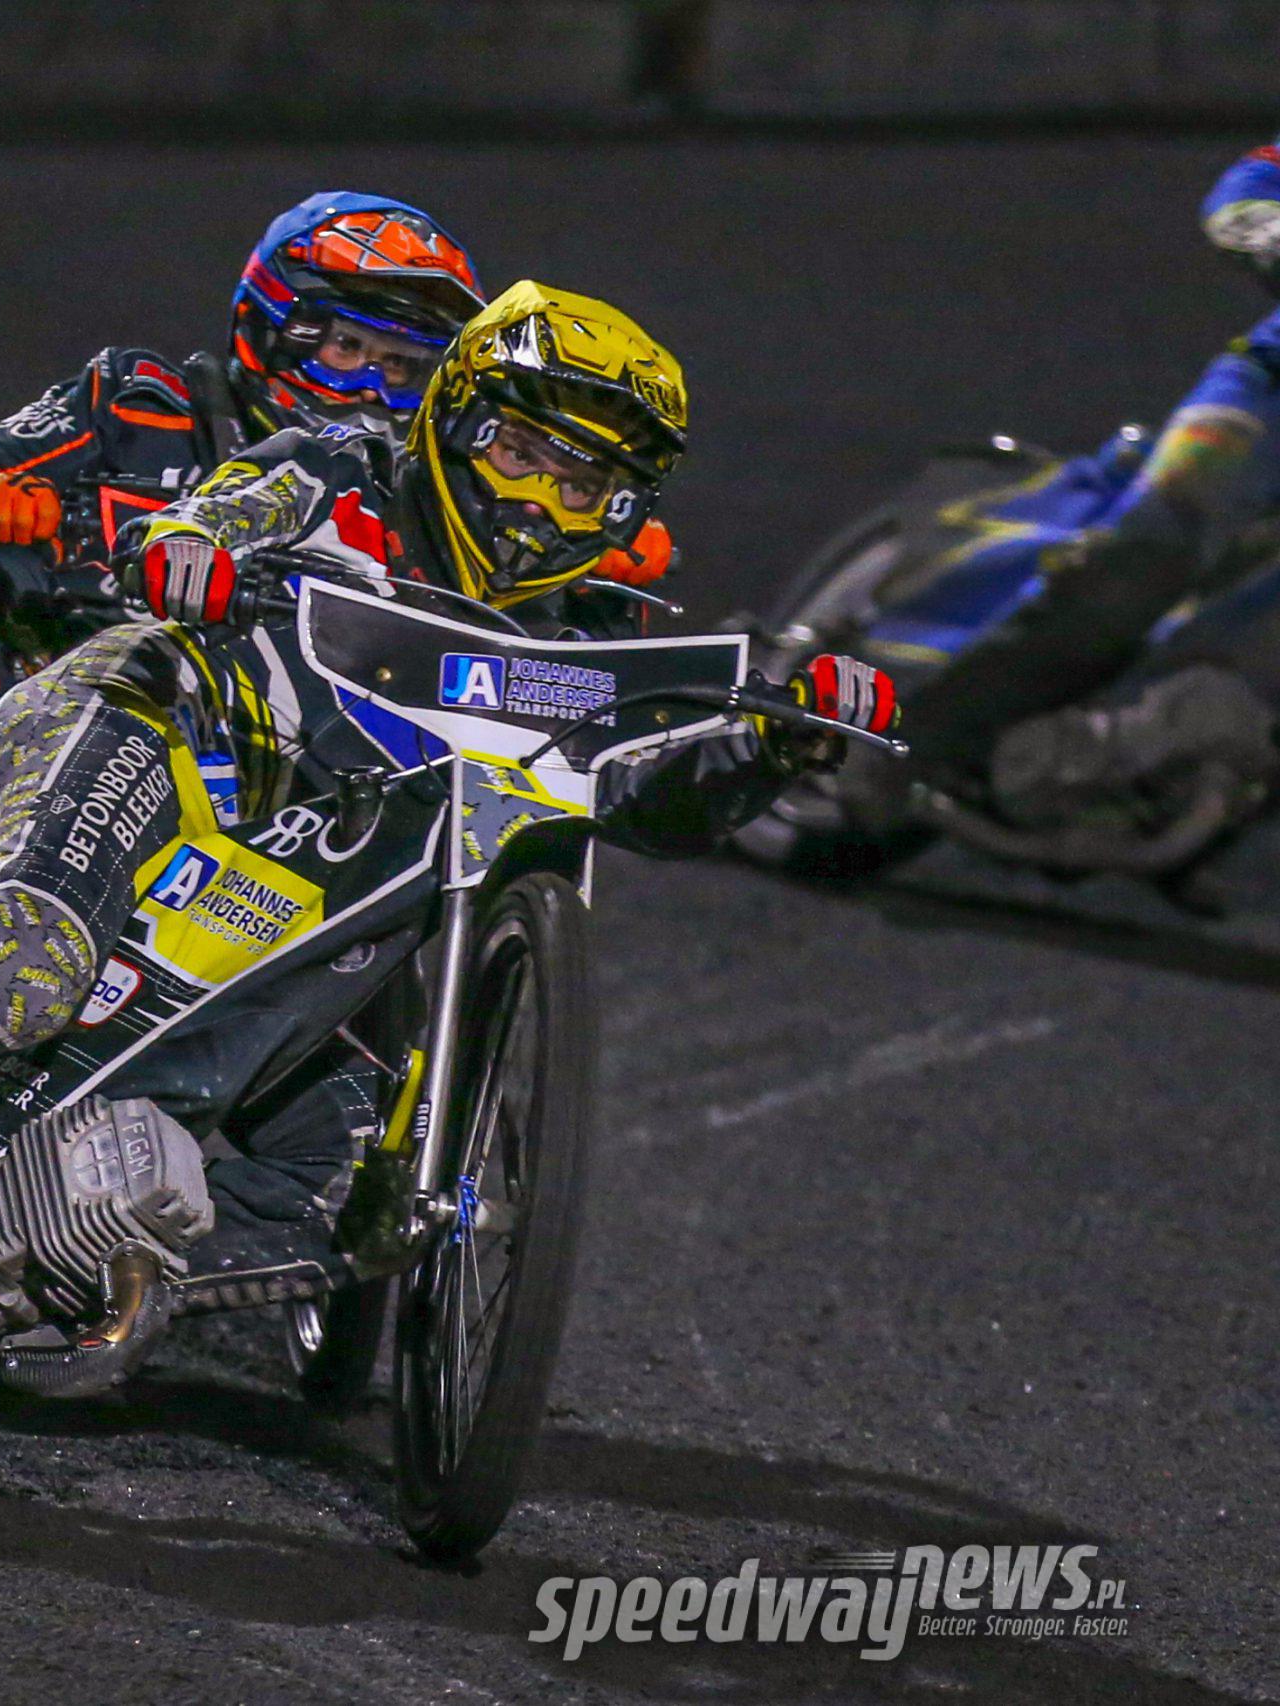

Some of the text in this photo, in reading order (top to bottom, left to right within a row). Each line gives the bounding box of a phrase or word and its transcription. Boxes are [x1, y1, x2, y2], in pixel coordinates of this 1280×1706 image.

[508, 658, 616, 693] JOHANNES
[59, 735, 157, 873] BETONBOOR
[112, 763, 173, 852] BLEEKER
[197, 890, 286, 945] ANDERSEN
